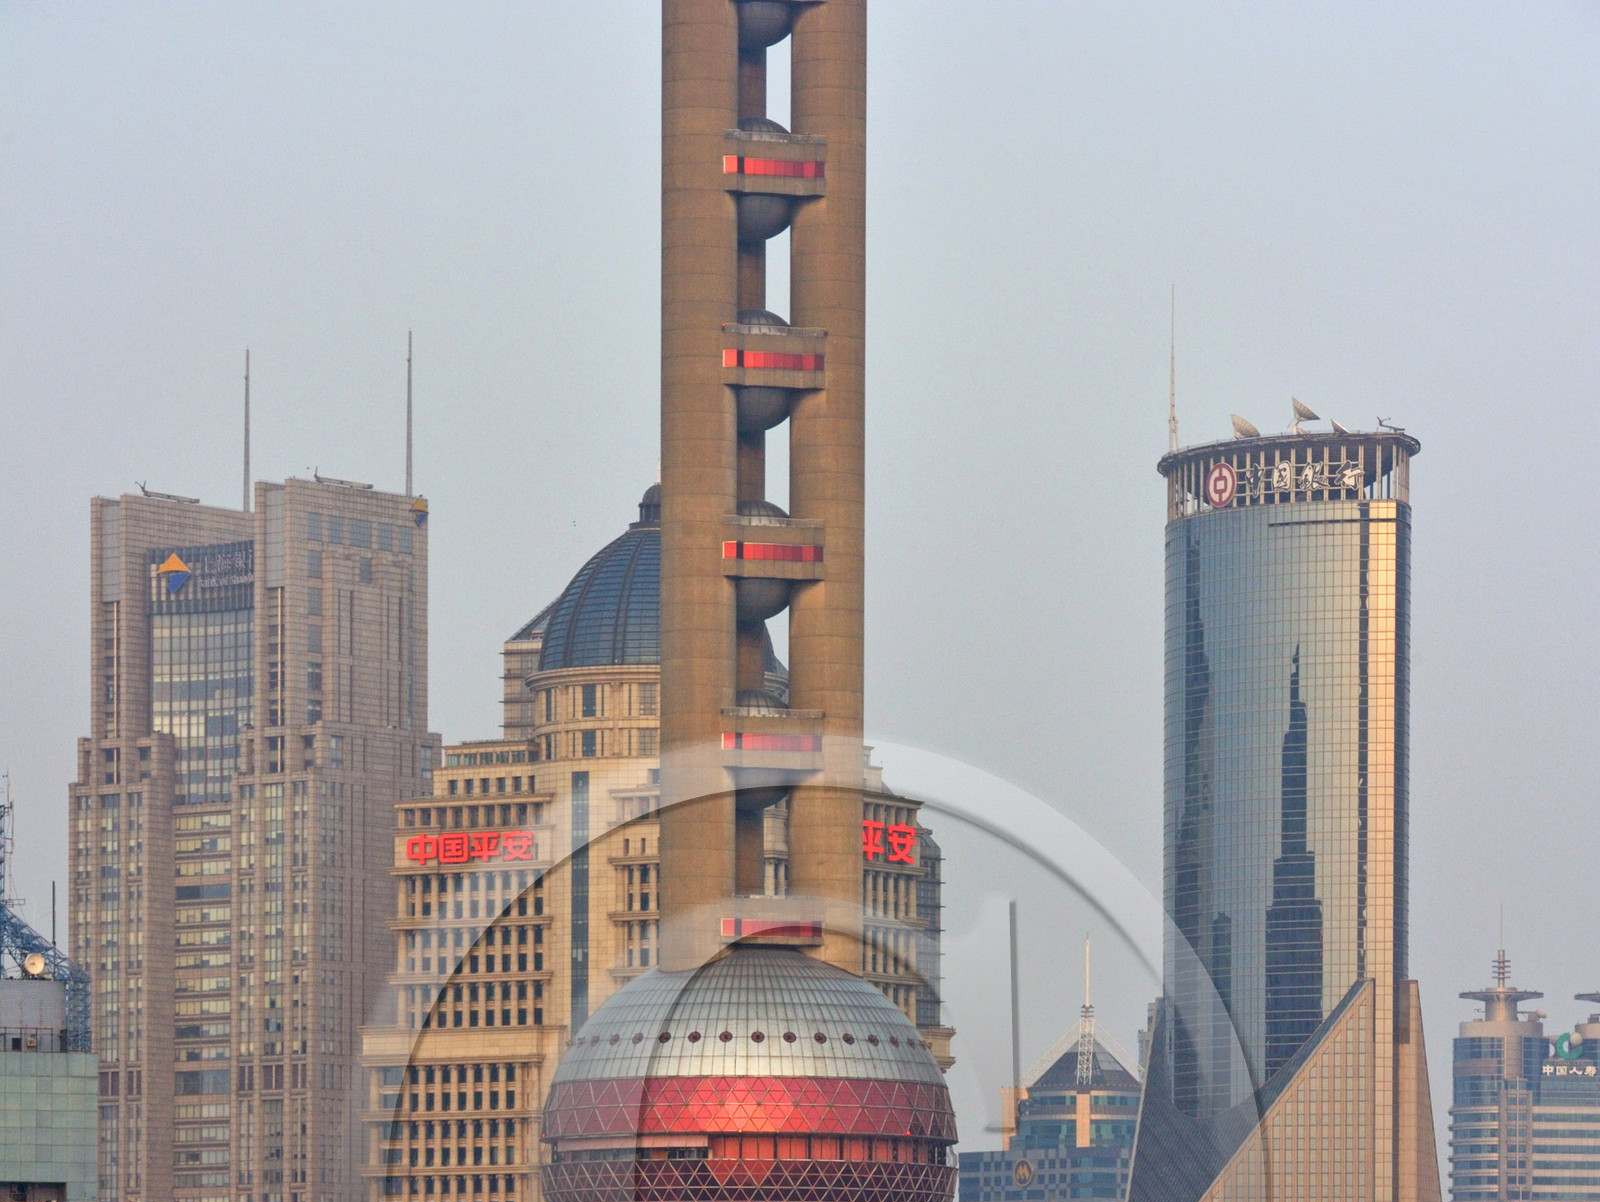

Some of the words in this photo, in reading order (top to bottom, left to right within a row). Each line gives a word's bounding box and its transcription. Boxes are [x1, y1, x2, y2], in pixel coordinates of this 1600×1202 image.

[406, 829, 533, 865] 中国平安
[862, 819, 916, 864] 平安
[1542, 1064, 1598, 1077] 中国人寿
